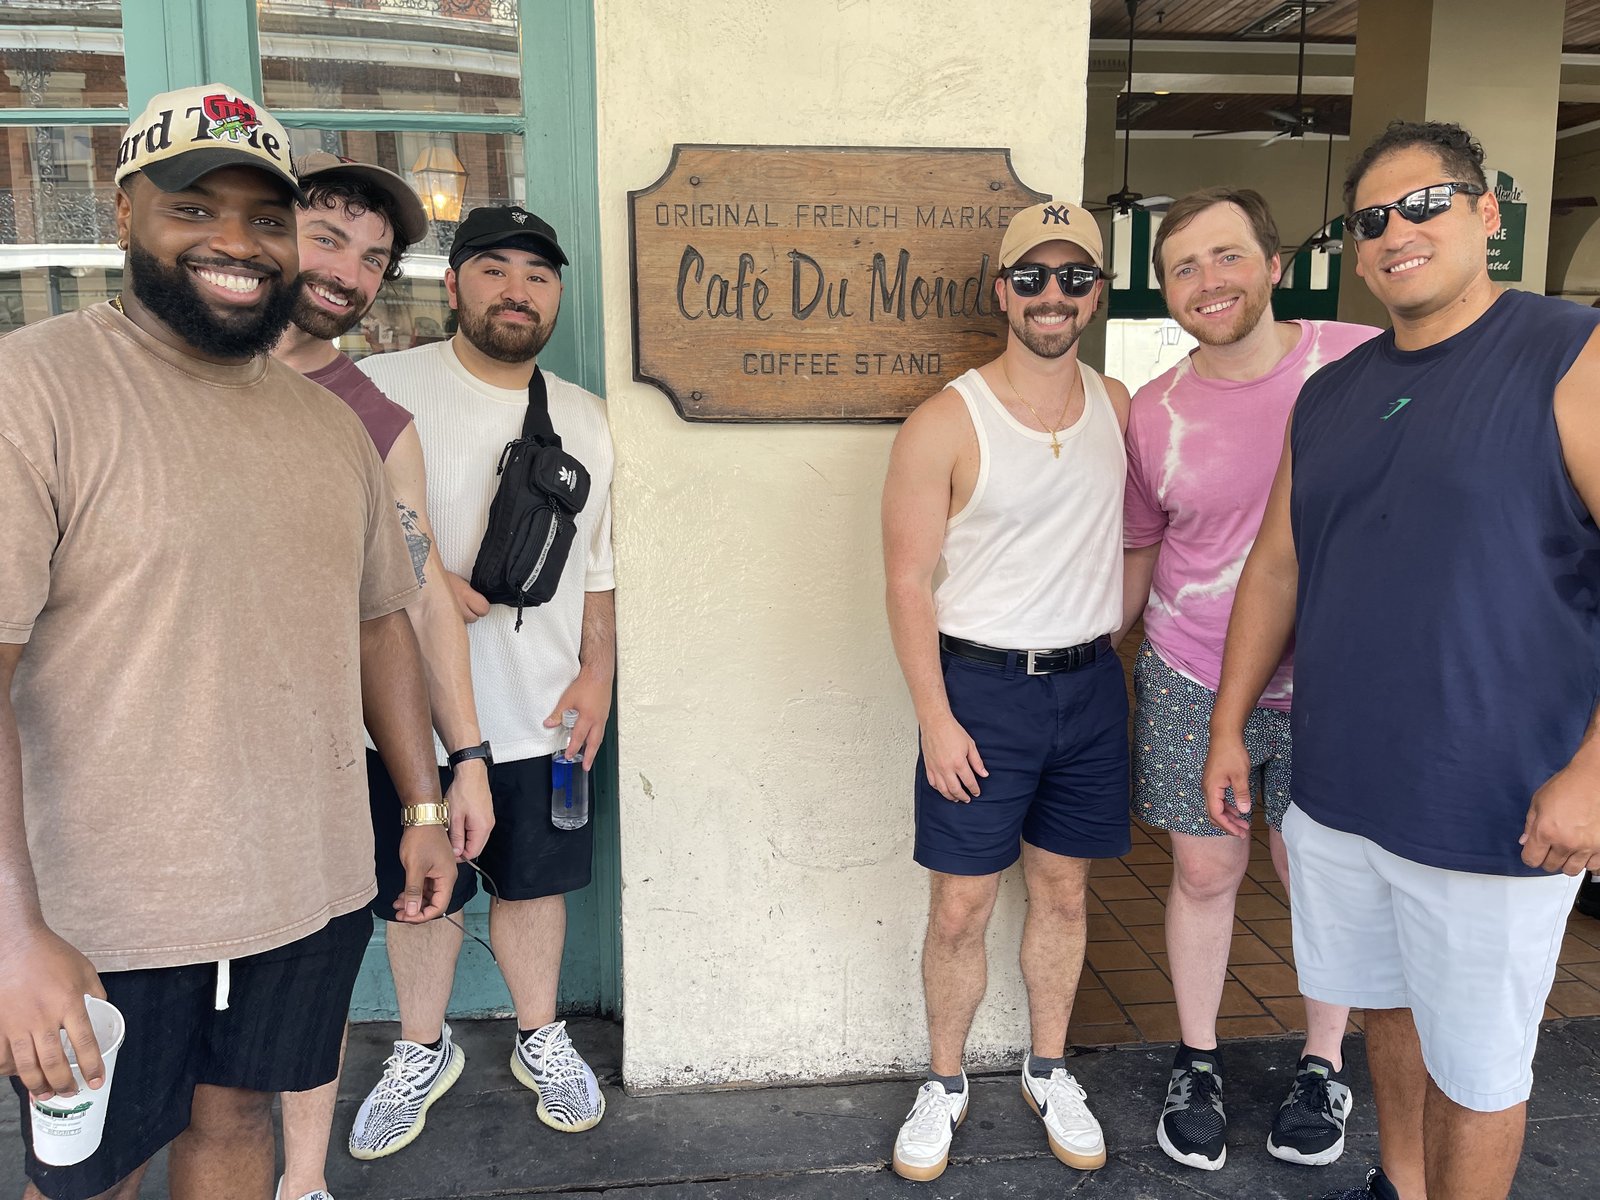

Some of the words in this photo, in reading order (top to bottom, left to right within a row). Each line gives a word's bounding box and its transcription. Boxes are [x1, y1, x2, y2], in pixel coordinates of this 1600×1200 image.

[115, 109, 173, 168] ard
[185, 107, 281, 161] Te
[656, 203, 779, 227] ORIGINAL
[796, 204, 898, 228] FRENCH
[1042, 205, 1070, 225] NY
[677, 244, 774, 321] Café
[787, 248, 854, 321] Du
[743, 353, 840, 376] COFFEE
[855, 353, 941, 376] STAND
